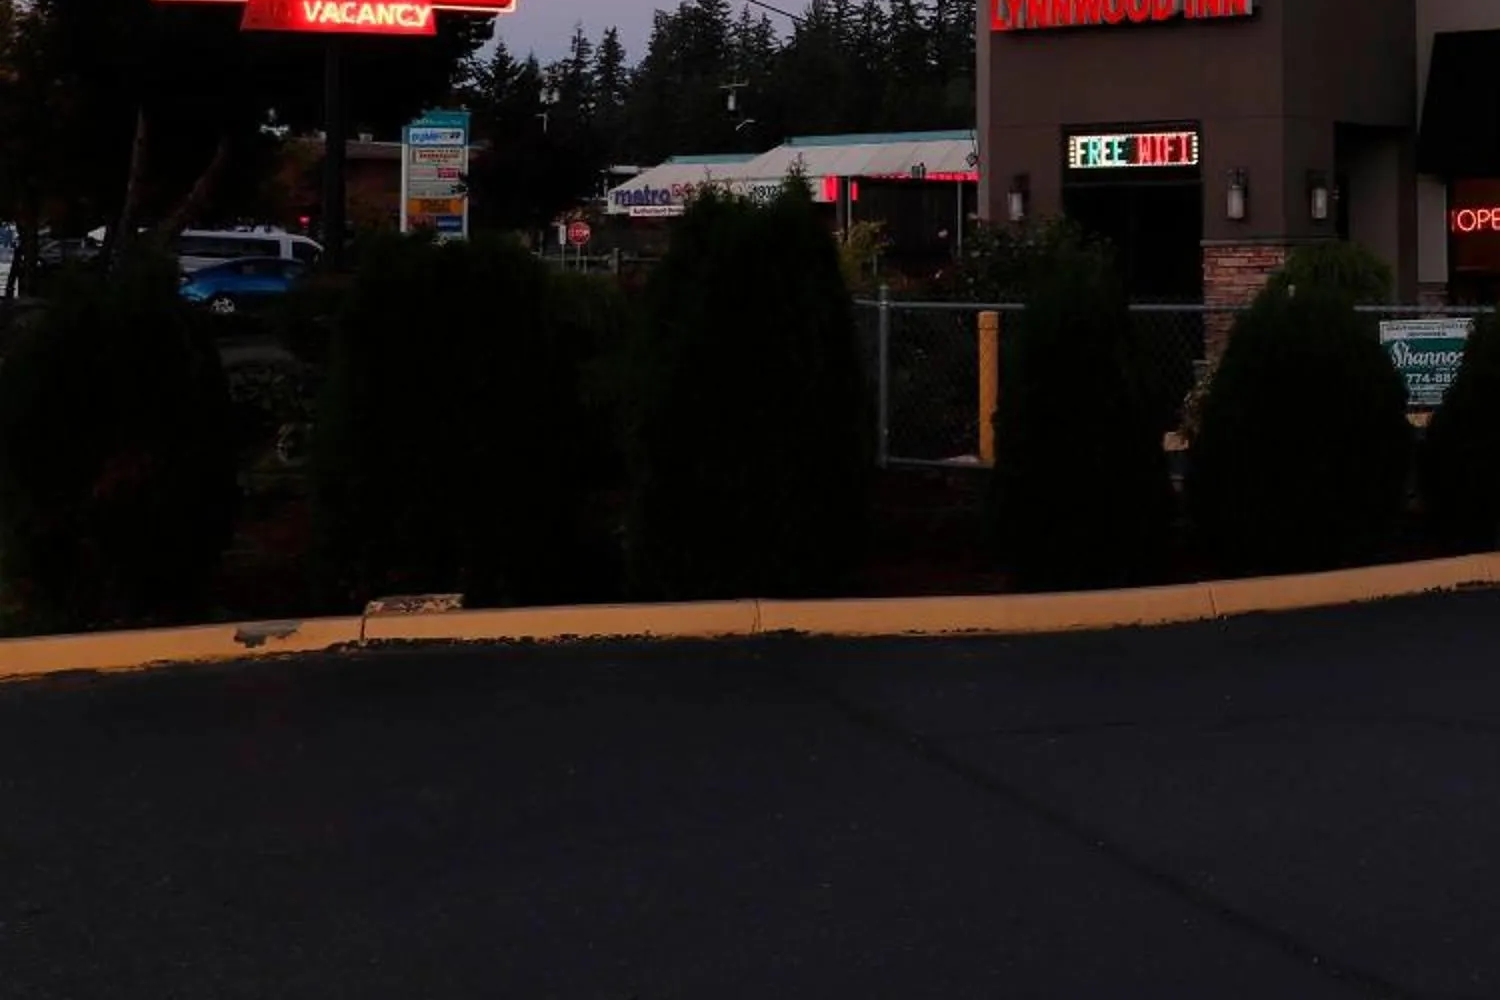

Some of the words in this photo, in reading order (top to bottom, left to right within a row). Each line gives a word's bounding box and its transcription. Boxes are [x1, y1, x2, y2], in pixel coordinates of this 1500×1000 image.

[303, 0, 433, 28] VACANCY
[1075, 136, 1127, 165] FREE
[1136, 133, 1189, 164] WIFI
